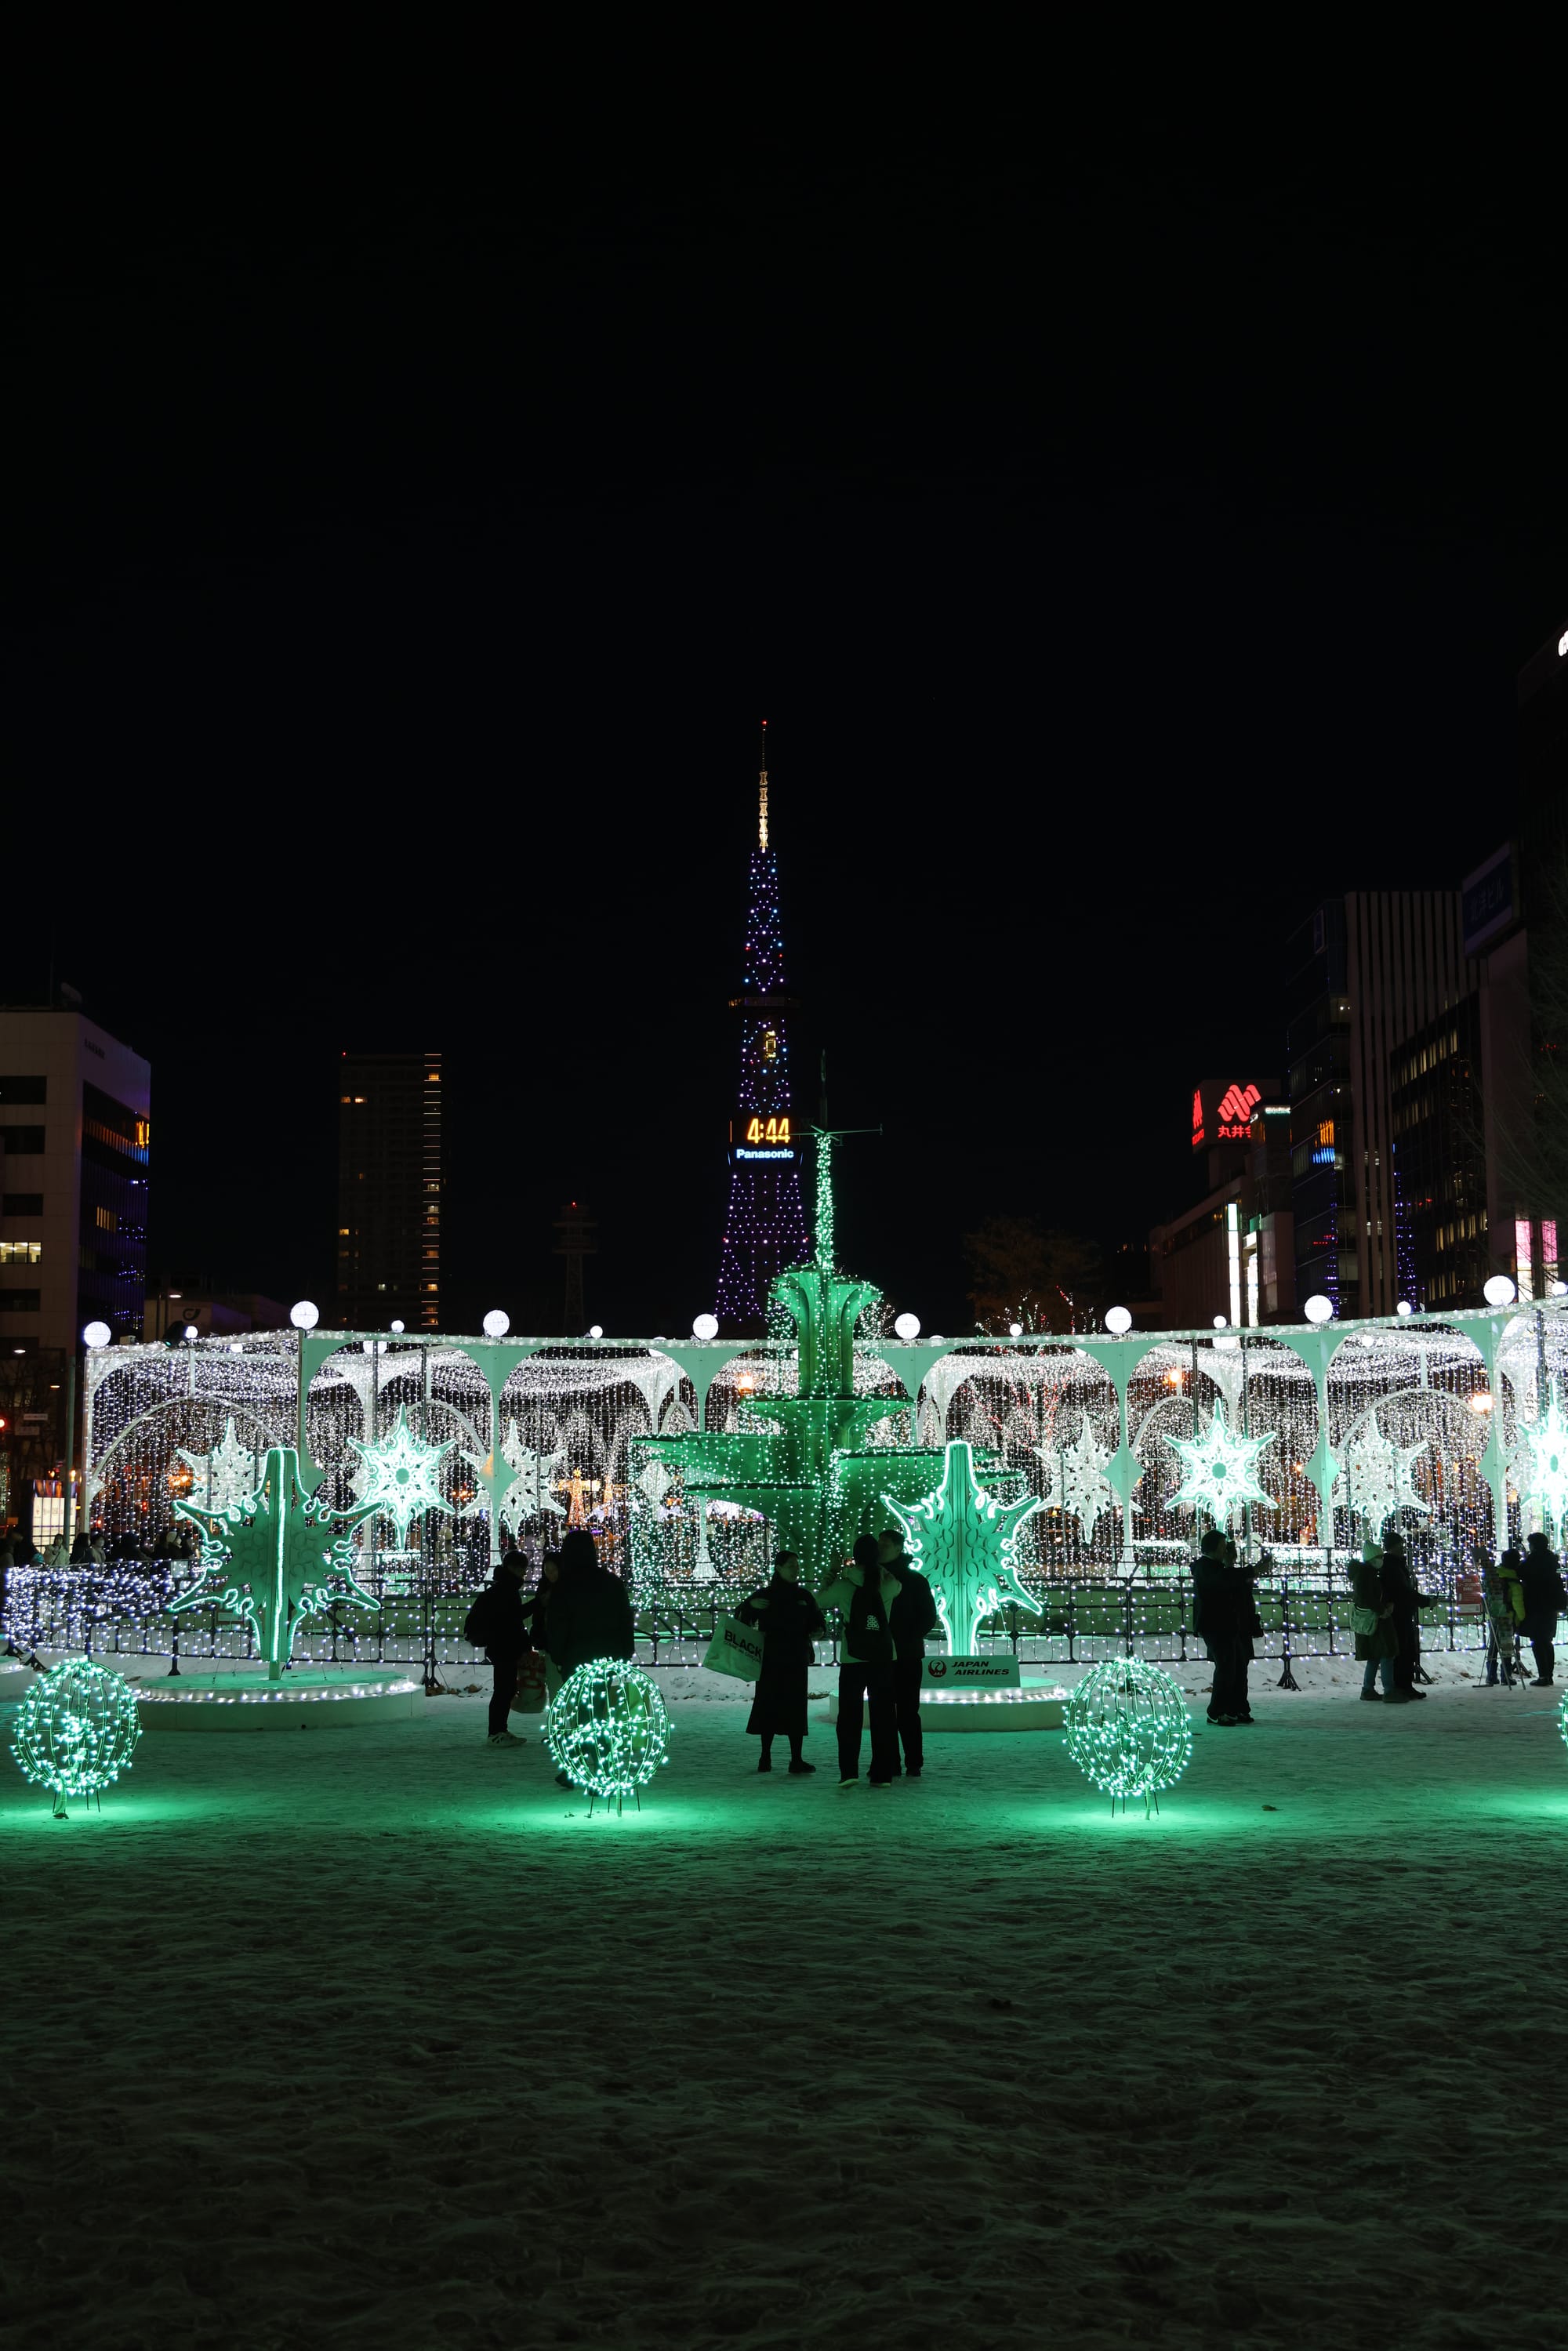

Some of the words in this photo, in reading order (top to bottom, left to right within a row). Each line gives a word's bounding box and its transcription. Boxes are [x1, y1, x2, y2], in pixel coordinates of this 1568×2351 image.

[747, 1118, 790, 1144] 4:44
[736, 1148, 794, 1159] Panasonic
[724, 1629, 763, 1660] BLACK
